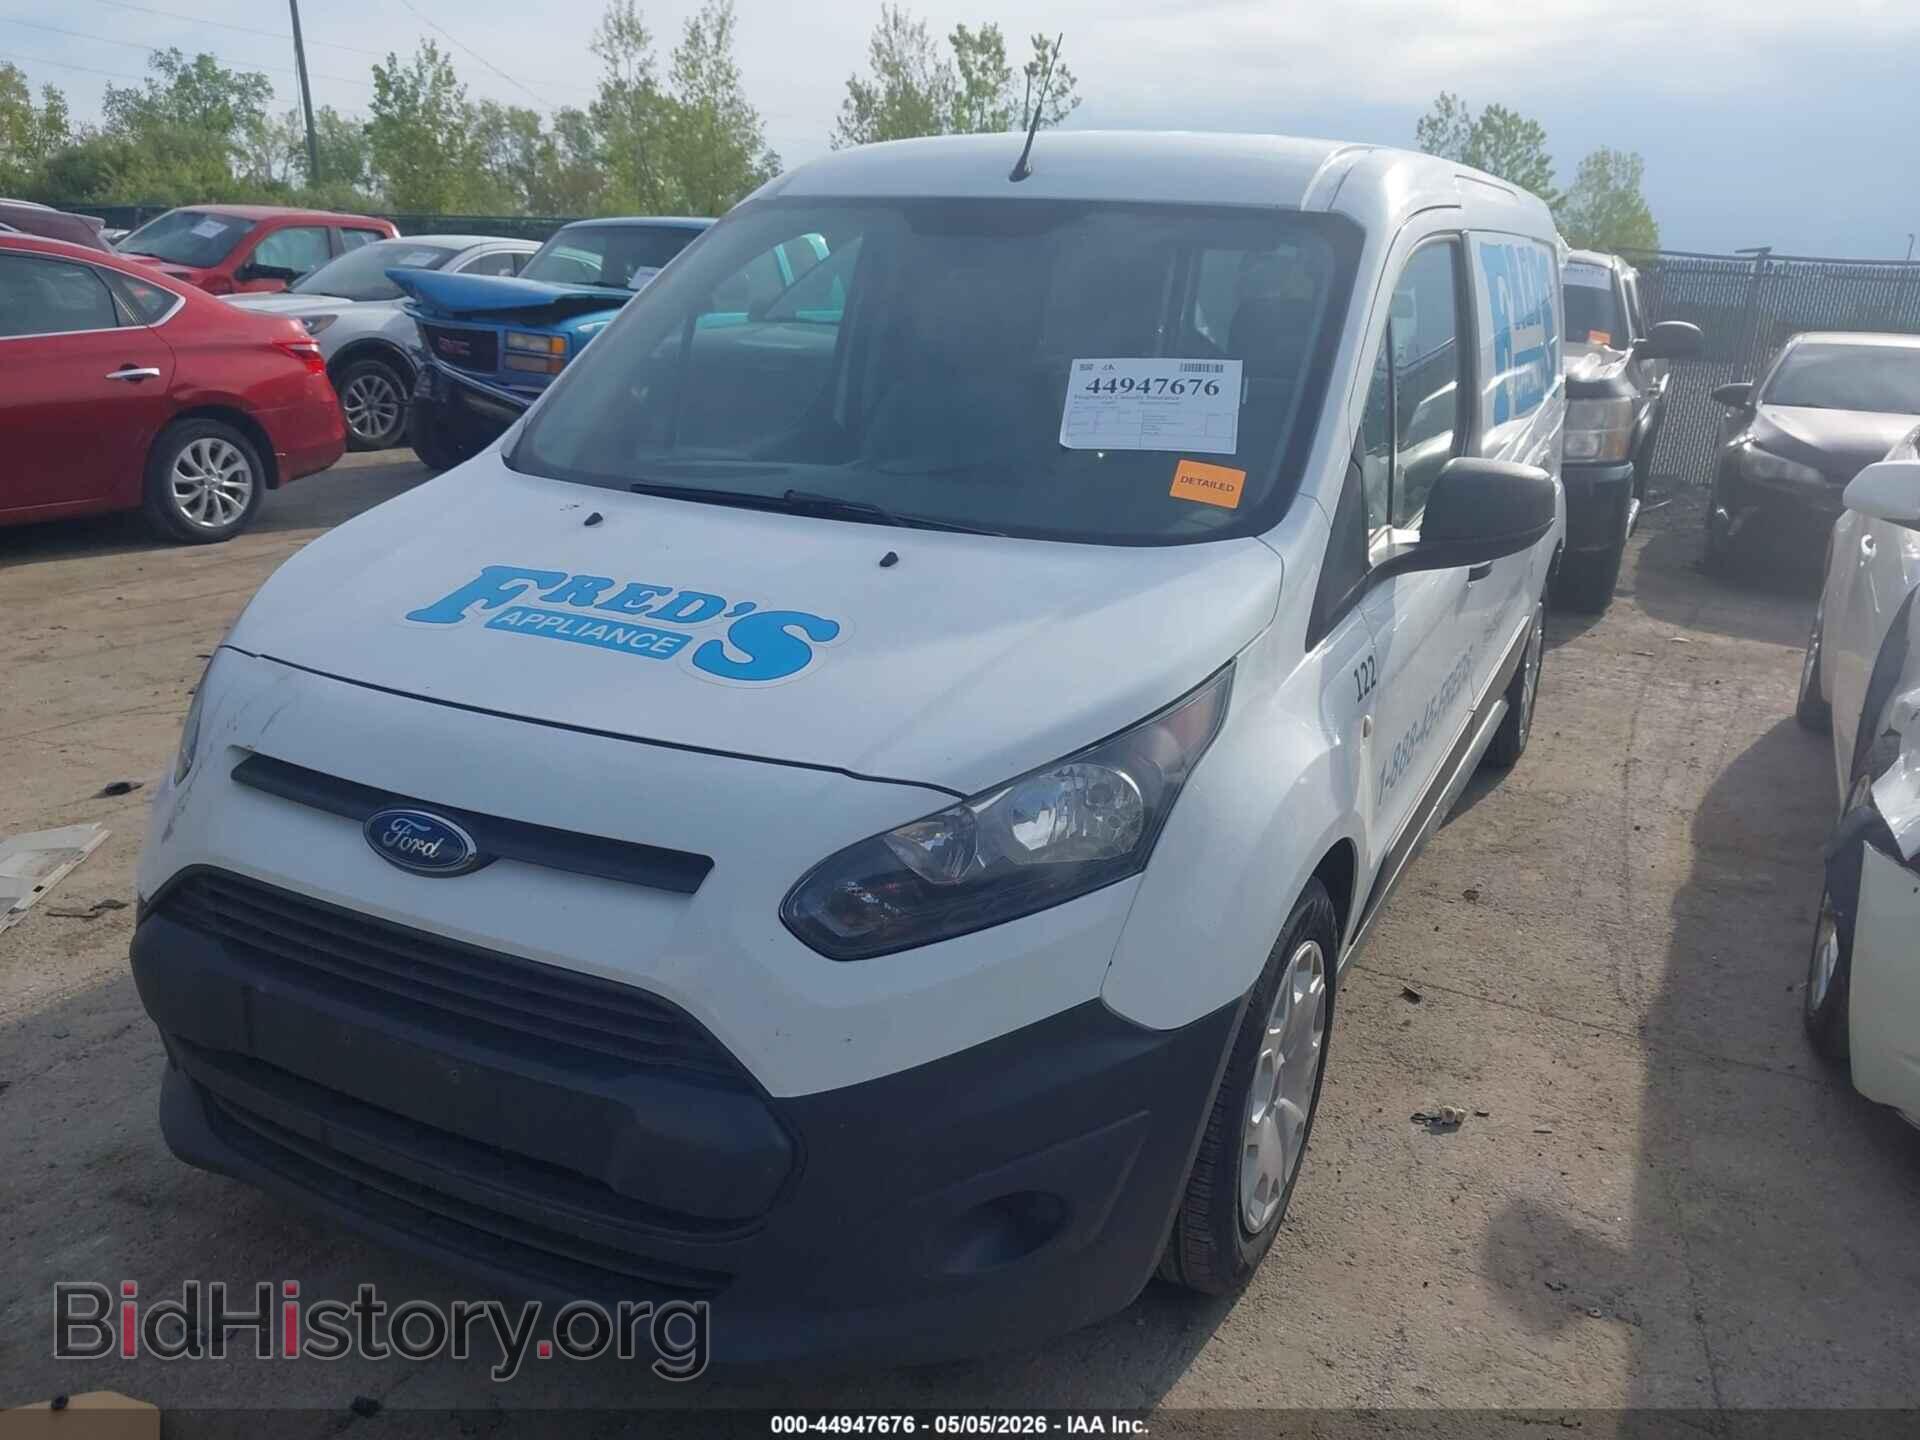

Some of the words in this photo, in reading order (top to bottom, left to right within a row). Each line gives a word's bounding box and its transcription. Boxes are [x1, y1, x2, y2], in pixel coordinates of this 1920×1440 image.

[1086, 377, 1220, 396] 44947676
[1180, 475, 1235, 493] DETAILED
[405, 565, 841, 681] FRED'S
[498, 609, 682, 655] APPLIANCE
[1353, 654, 1377, 703] 122
[382, 817, 444, 858] Ford
